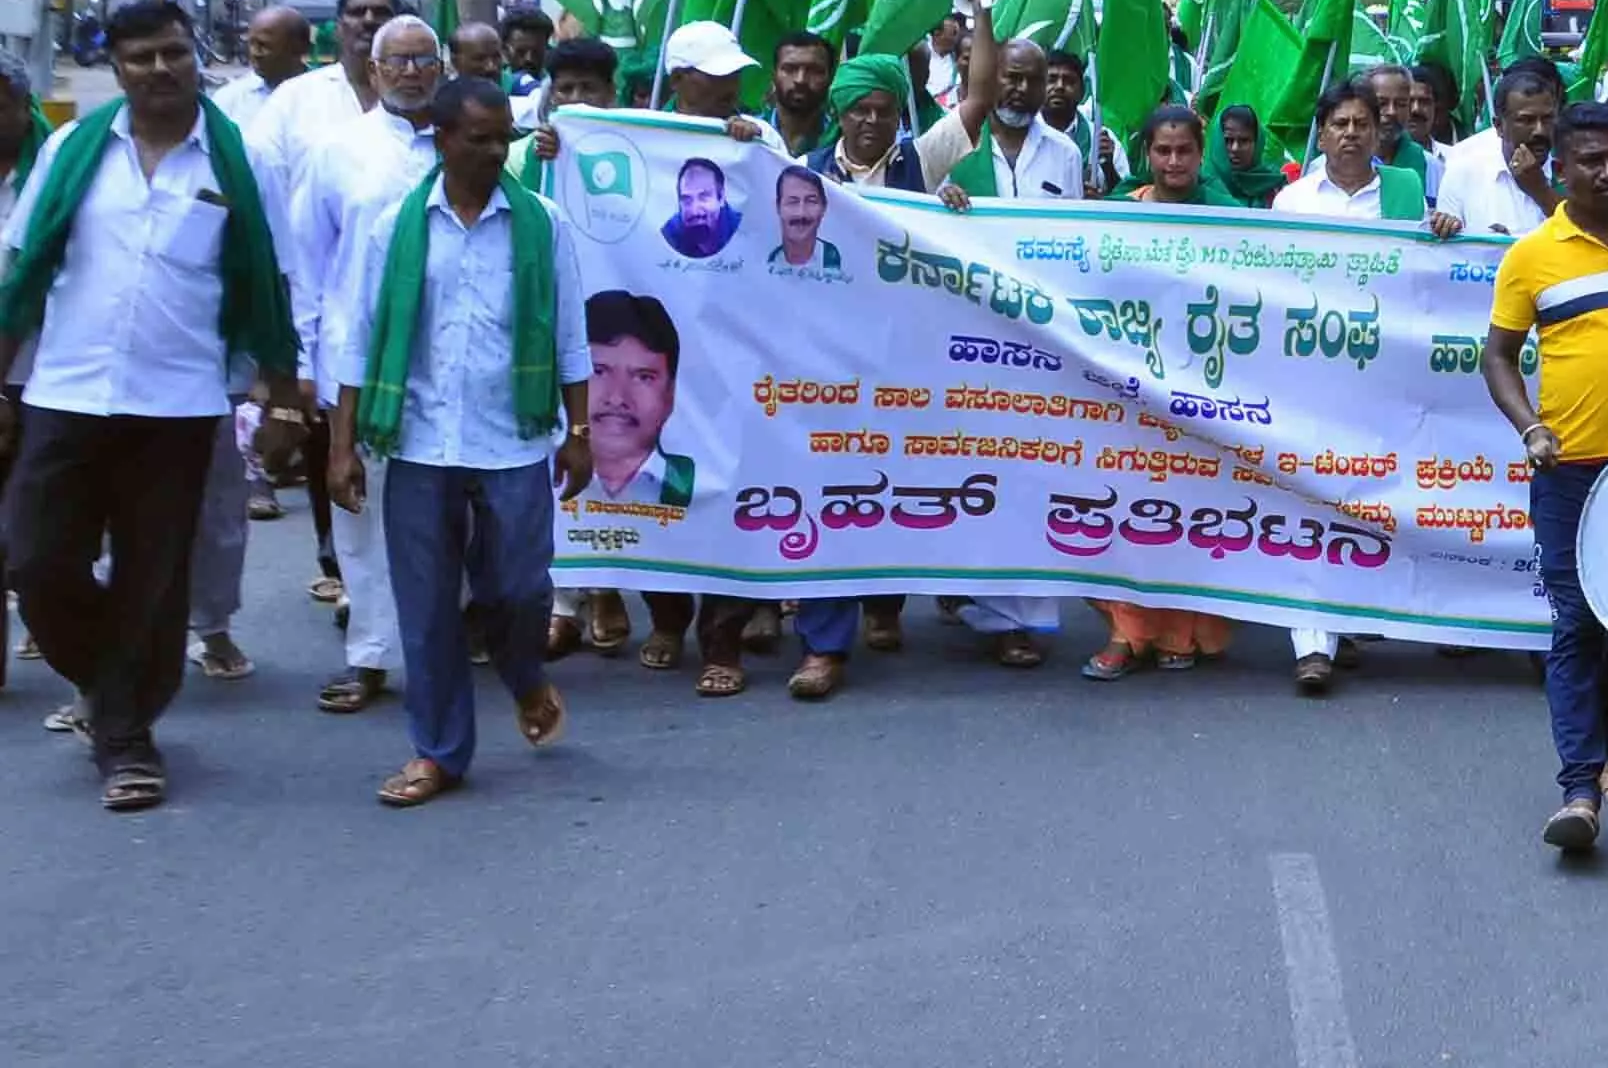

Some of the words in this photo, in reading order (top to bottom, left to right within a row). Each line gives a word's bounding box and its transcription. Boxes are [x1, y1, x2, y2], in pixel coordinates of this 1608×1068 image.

[877, 230, 1055, 325] ಕರ್ನಾಟಕ
[1066, 297, 1166, 380] ರಾಜ್ಯ
[1186, 283, 1263, 389] ರೈತ
[1283, 290, 1381, 371] ಸಂಘ
[949, 334, 1063, 372] ಹಾಸನ
[1169, 389, 1272, 425] ಹಾಸನ
[753, 375, 861, 417] ರೈತರಿಂದ
[873, 384, 931, 408] ಸಾಲ
[944, 381, 1126, 423] ವಸೂಲಾತಿಗಾಗಿ
[1415, 454, 1494, 489] ಪ್ರಕ್ರಿಯೆ
[809, 428, 890, 455] ಹಾಗೂ
[903, 430, 1084, 467] ಸಾರ್ವಜನಿಕರಿಗೆ
[1095, 444, 1222, 483] ಸಿಗುತ್ತಿರುವ
[733, 468, 999, 561] ಬೃಹತ್
